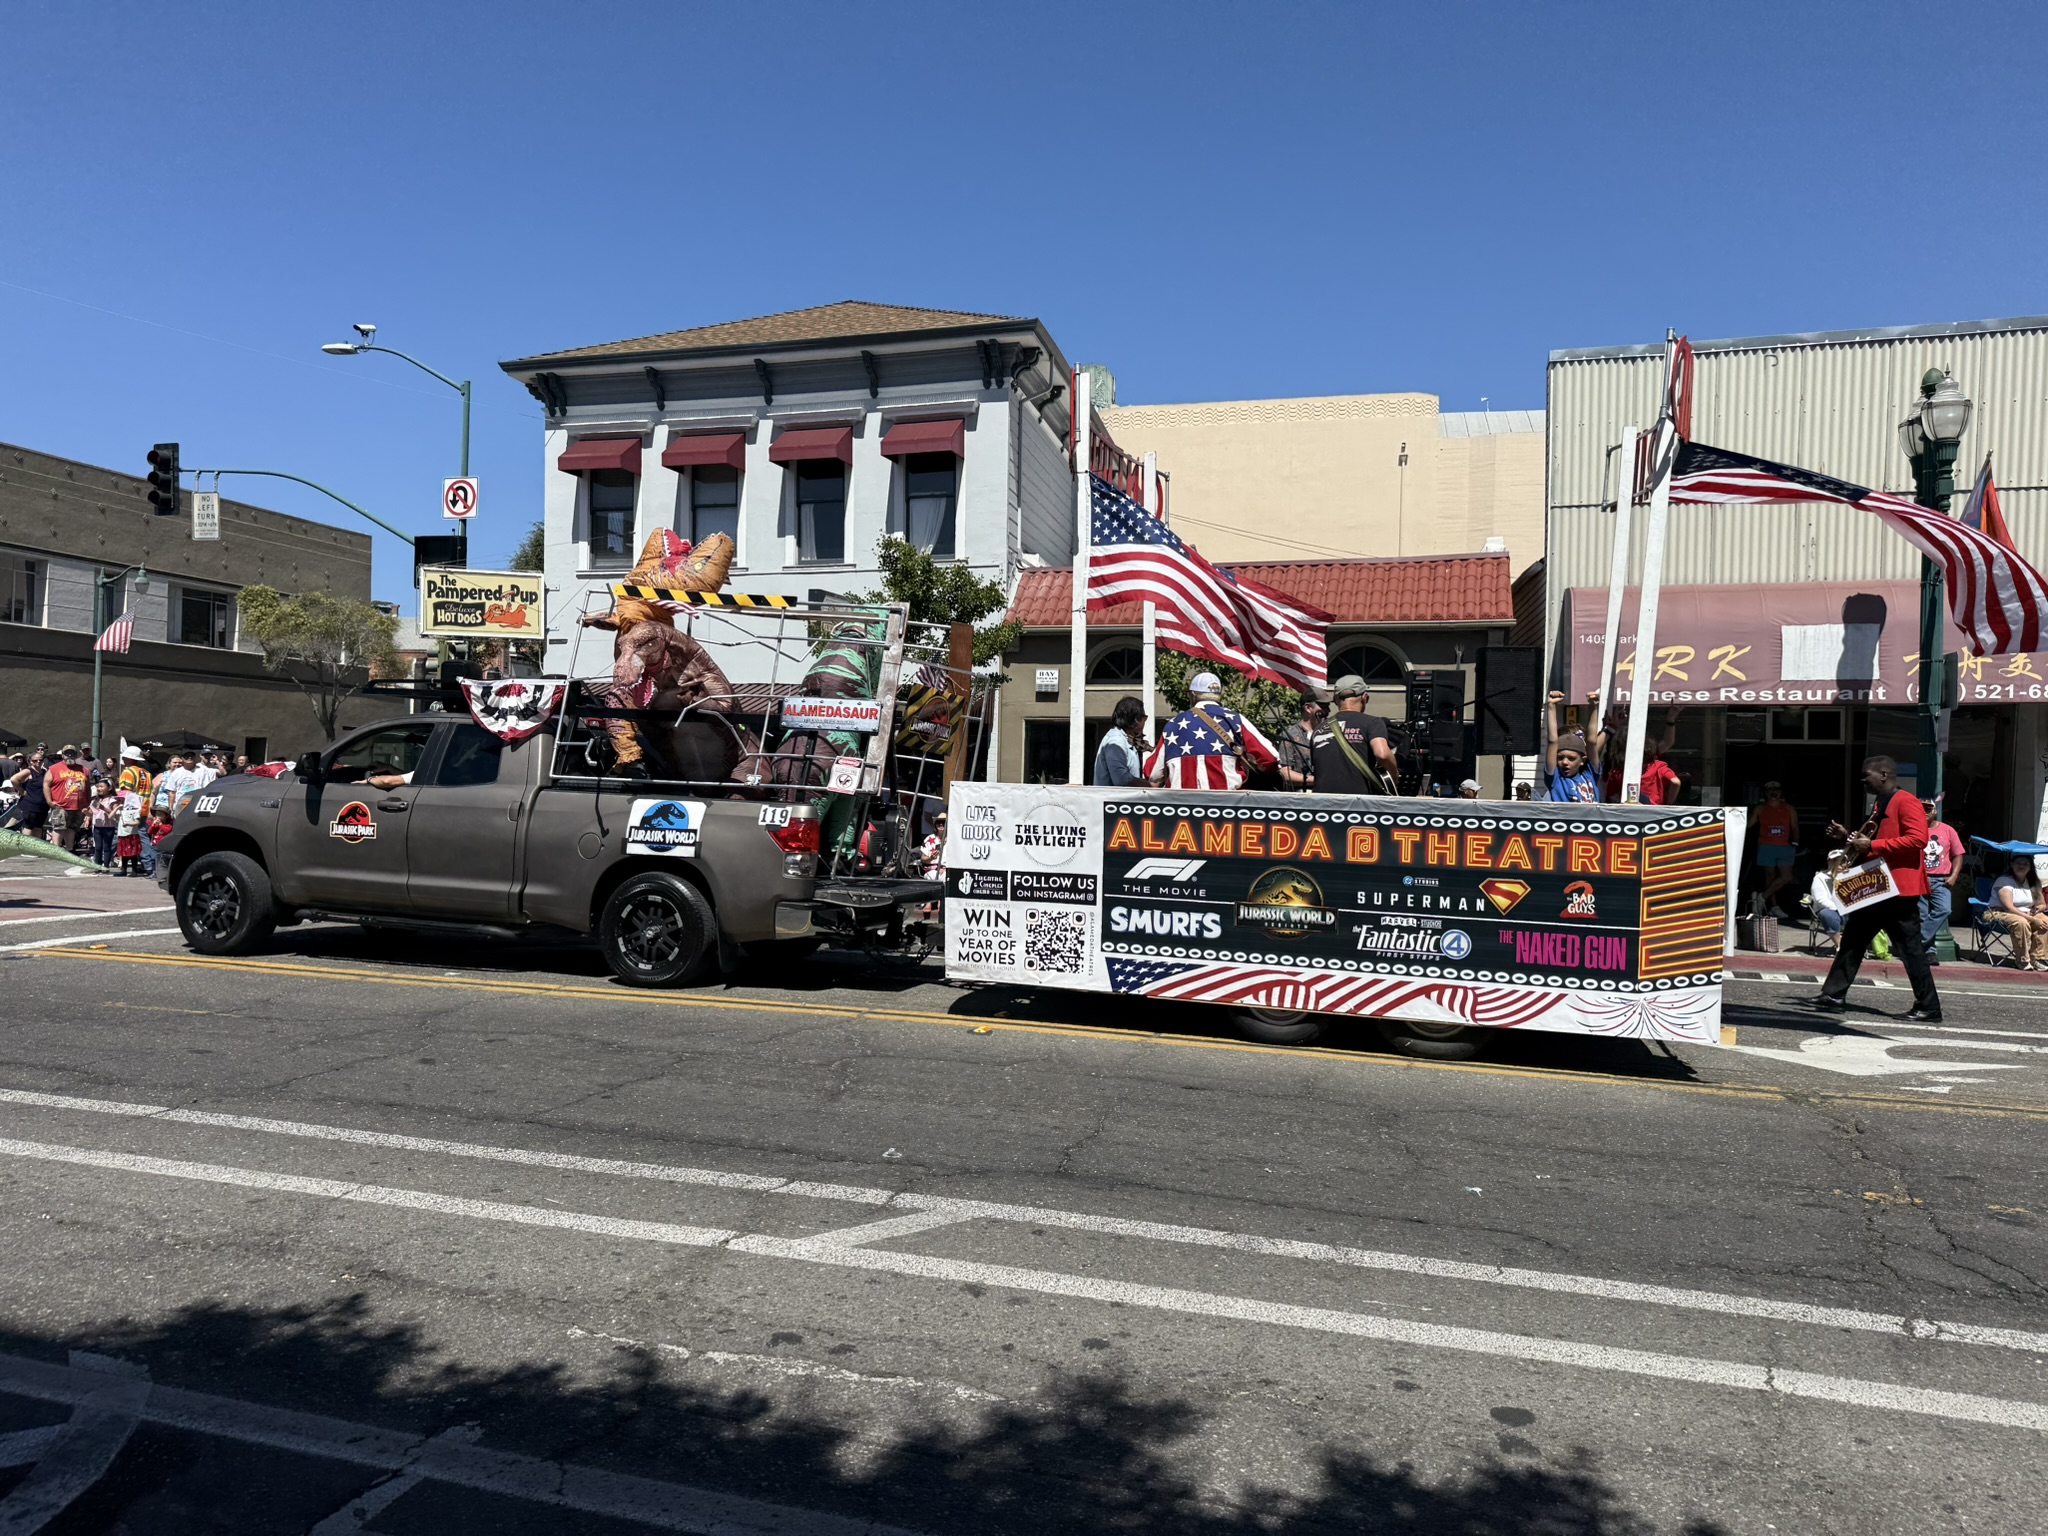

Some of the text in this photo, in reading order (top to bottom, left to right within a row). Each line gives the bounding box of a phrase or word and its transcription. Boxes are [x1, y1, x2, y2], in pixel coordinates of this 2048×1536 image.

[440, 575, 456, 586] The
[427, 580, 538, 605] Pampered Pup
[437, 609, 482, 624] HOT DOGS
[1620, 634, 1637, 644] ark
[1720, 686, 1886, 700] Restaurant
[784, 704, 879, 720] ALAMEDASAUR
[199, 796, 219, 811] 119
[761, 807, 789, 824] 119
[966, 805, 996, 821] LIVE
[332, 824, 375, 837] JURASSIC PARK
[628, 828, 696, 844] JURASSIC WORLD
[961, 825, 1002, 841] MUSIC
[1015, 824, 1087, 836] THE LIVING
[1015, 835, 1087, 848] DAYLIGHT
[1109, 819, 1332, 858] ALAMEDA
[1393, 832, 1637, 874] THEATRE
[970, 844, 991, 859] BY
[1013, 875, 1095, 890] FOLLOW US
[1123, 884, 1207, 897] THE MOVIE
[1572, 892, 1596, 904] BAD
[1357, 891, 1485, 911] SUPERMAN
[1238, 905, 1335, 925] JURASSIC WORLD
[1567, 903, 1596, 915] GUYS
[963, 908, 1011, 928] WIN
[1110, 906, 1222, 939] SMURFS
[1380, 916, 1417, 927] MARVEL
[962, 928, 1013, 938] UP TO ONE
[1352, 925, 1464, 955] the Fantastic 4
[959, 938, 1017, 951] YEAR OF
[1499, 930, 1627, 971] THE NAKED GUN
[958, 950, 1016, 965] MOVIES
[1376, 951, 1440, 961] FIRST STEPS
